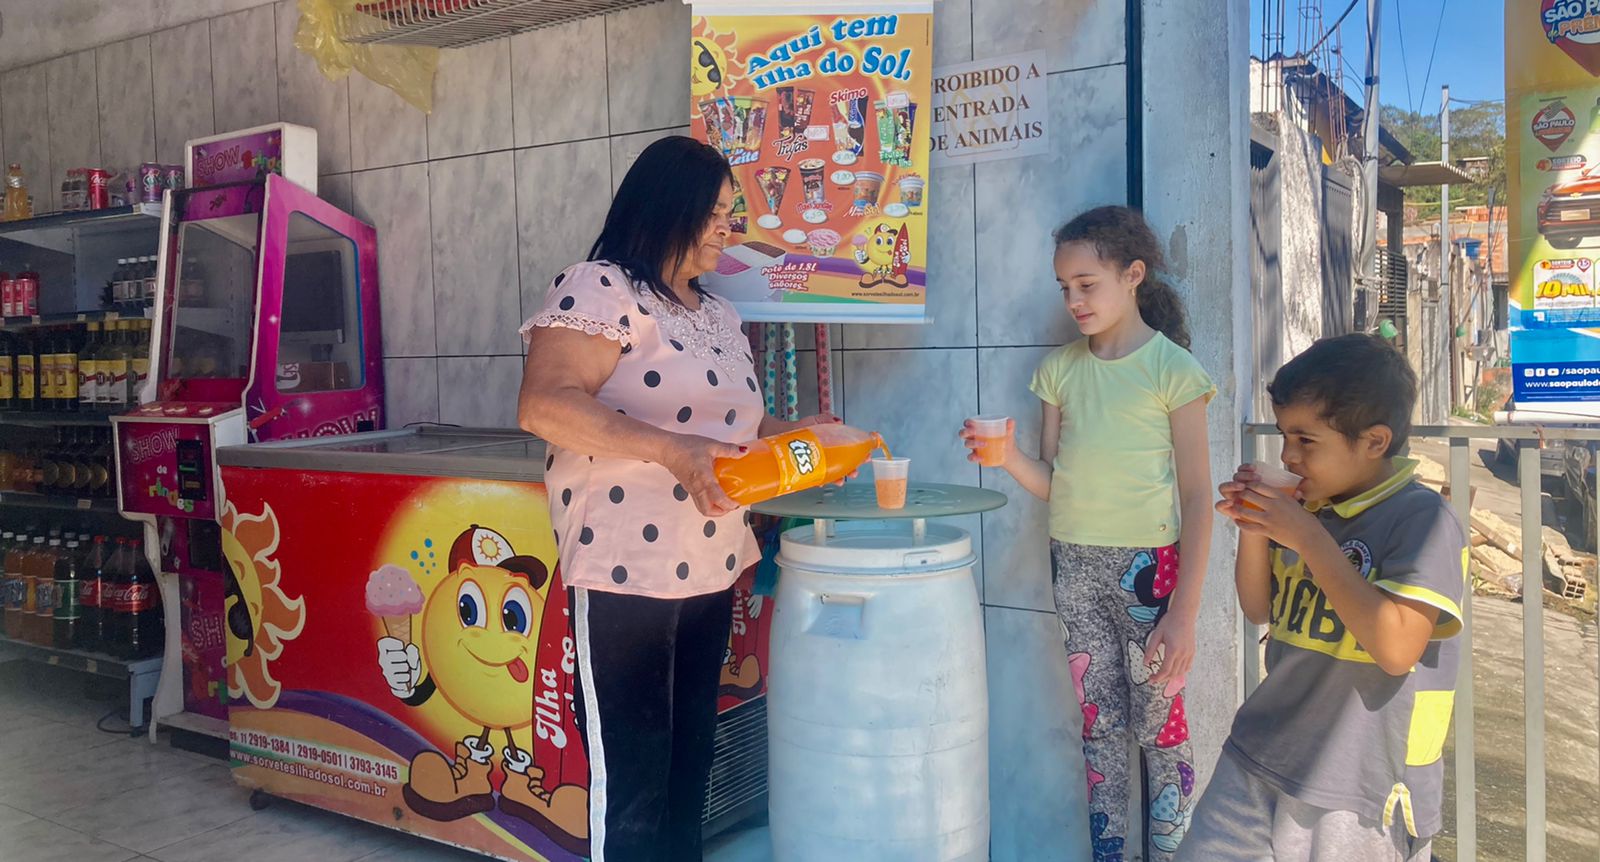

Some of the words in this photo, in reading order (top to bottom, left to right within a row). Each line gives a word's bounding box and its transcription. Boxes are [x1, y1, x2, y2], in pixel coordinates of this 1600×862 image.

[1545, 1, 1582, 23] SÃO
[831, 14, 898, 41] tem
[752, 62, 811, 89] Ilha
[819, 50, 854, 73] do
[931, 65, 1020, 94] ROIBIDO
[1026, 62, 1040, 80] A
[830, 86, 868, 106] Skimo
[934, 94, 1029, 123] ENTRADA
[954, 121, 1043, 149] ANIMAIS
[1550, 118, 1575, 128] PAULO
[198, 144, 240, 177] SHOW
[773, 136, 808, 160] Trufas
[769, 272, 808, 282] Diversos
[784, 262, 797, 272] de
[1525, 379, 1600, 389] www.saopaulod
[130, 426, 180, 465] SHOW
[157, 465, 168, 475] de
[248, 732, 290, 754] 2919-1384
[297, 744, 342, 767] 2919-0501
[350, 757, 398, 780] 3793-3145
